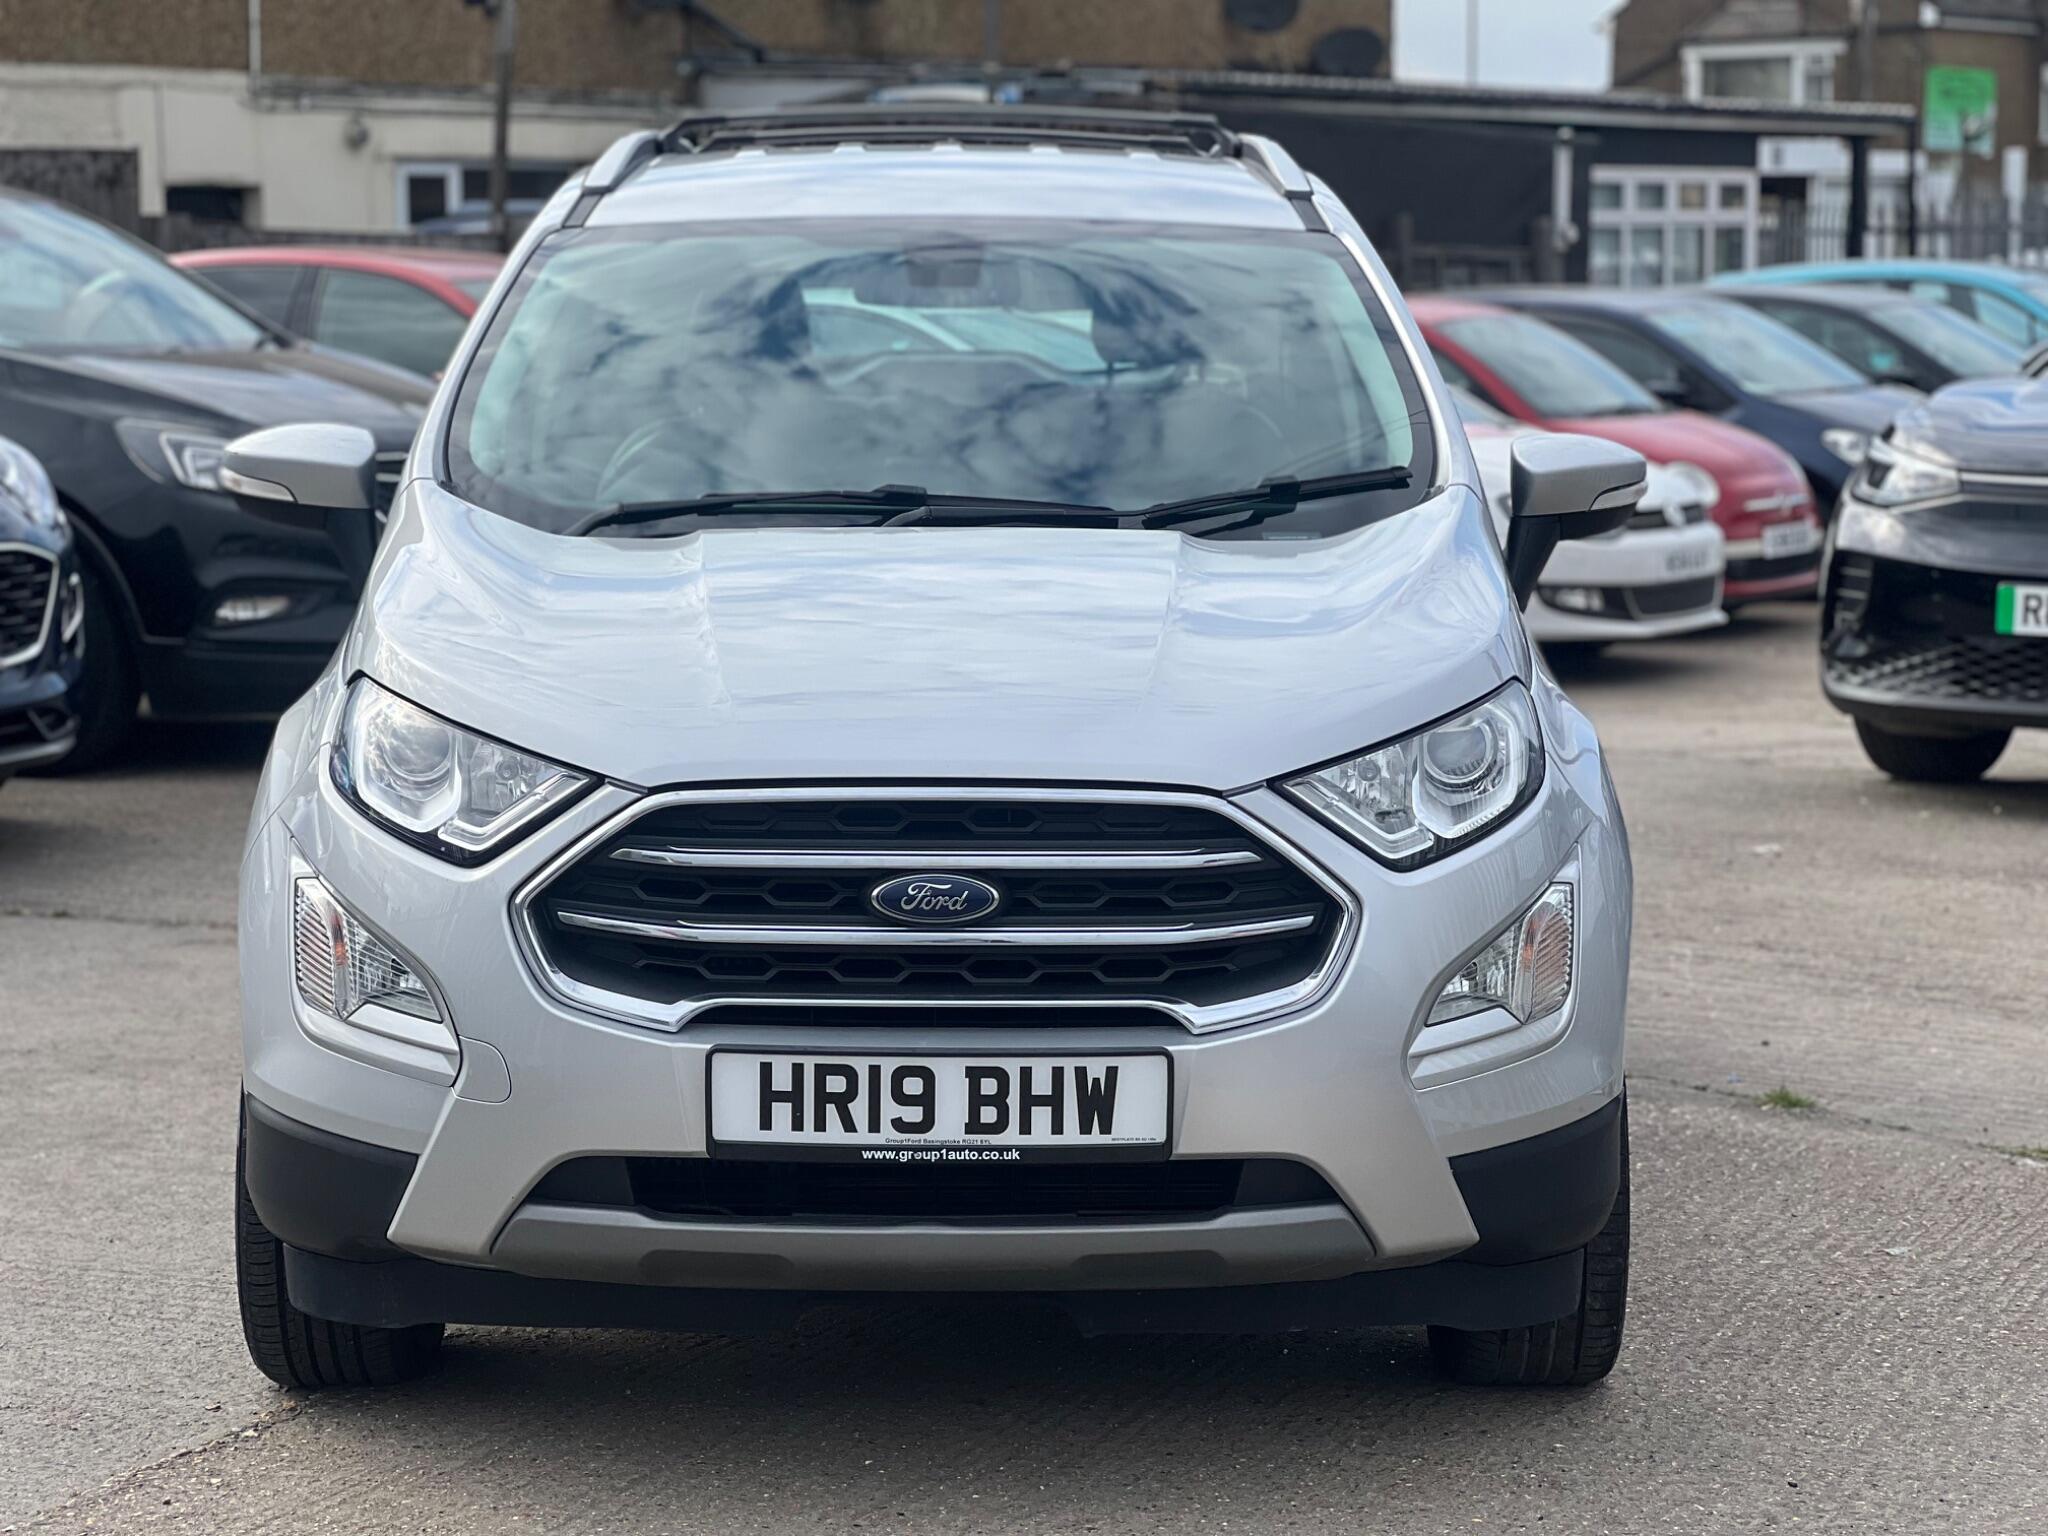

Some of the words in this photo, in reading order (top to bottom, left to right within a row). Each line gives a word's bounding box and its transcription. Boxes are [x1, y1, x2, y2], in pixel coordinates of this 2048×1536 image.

[2023, 594, 2048, 626] R
[901, 882, 968, 910] Ford
[759, 1061, 936, 1134] HR19
[964, 1066, 1119, 1135] BHW
[861, 1148, 1020, 1162] www.group1auto.co.uk
[923, 1138, 960, 1146] Basingstoke
